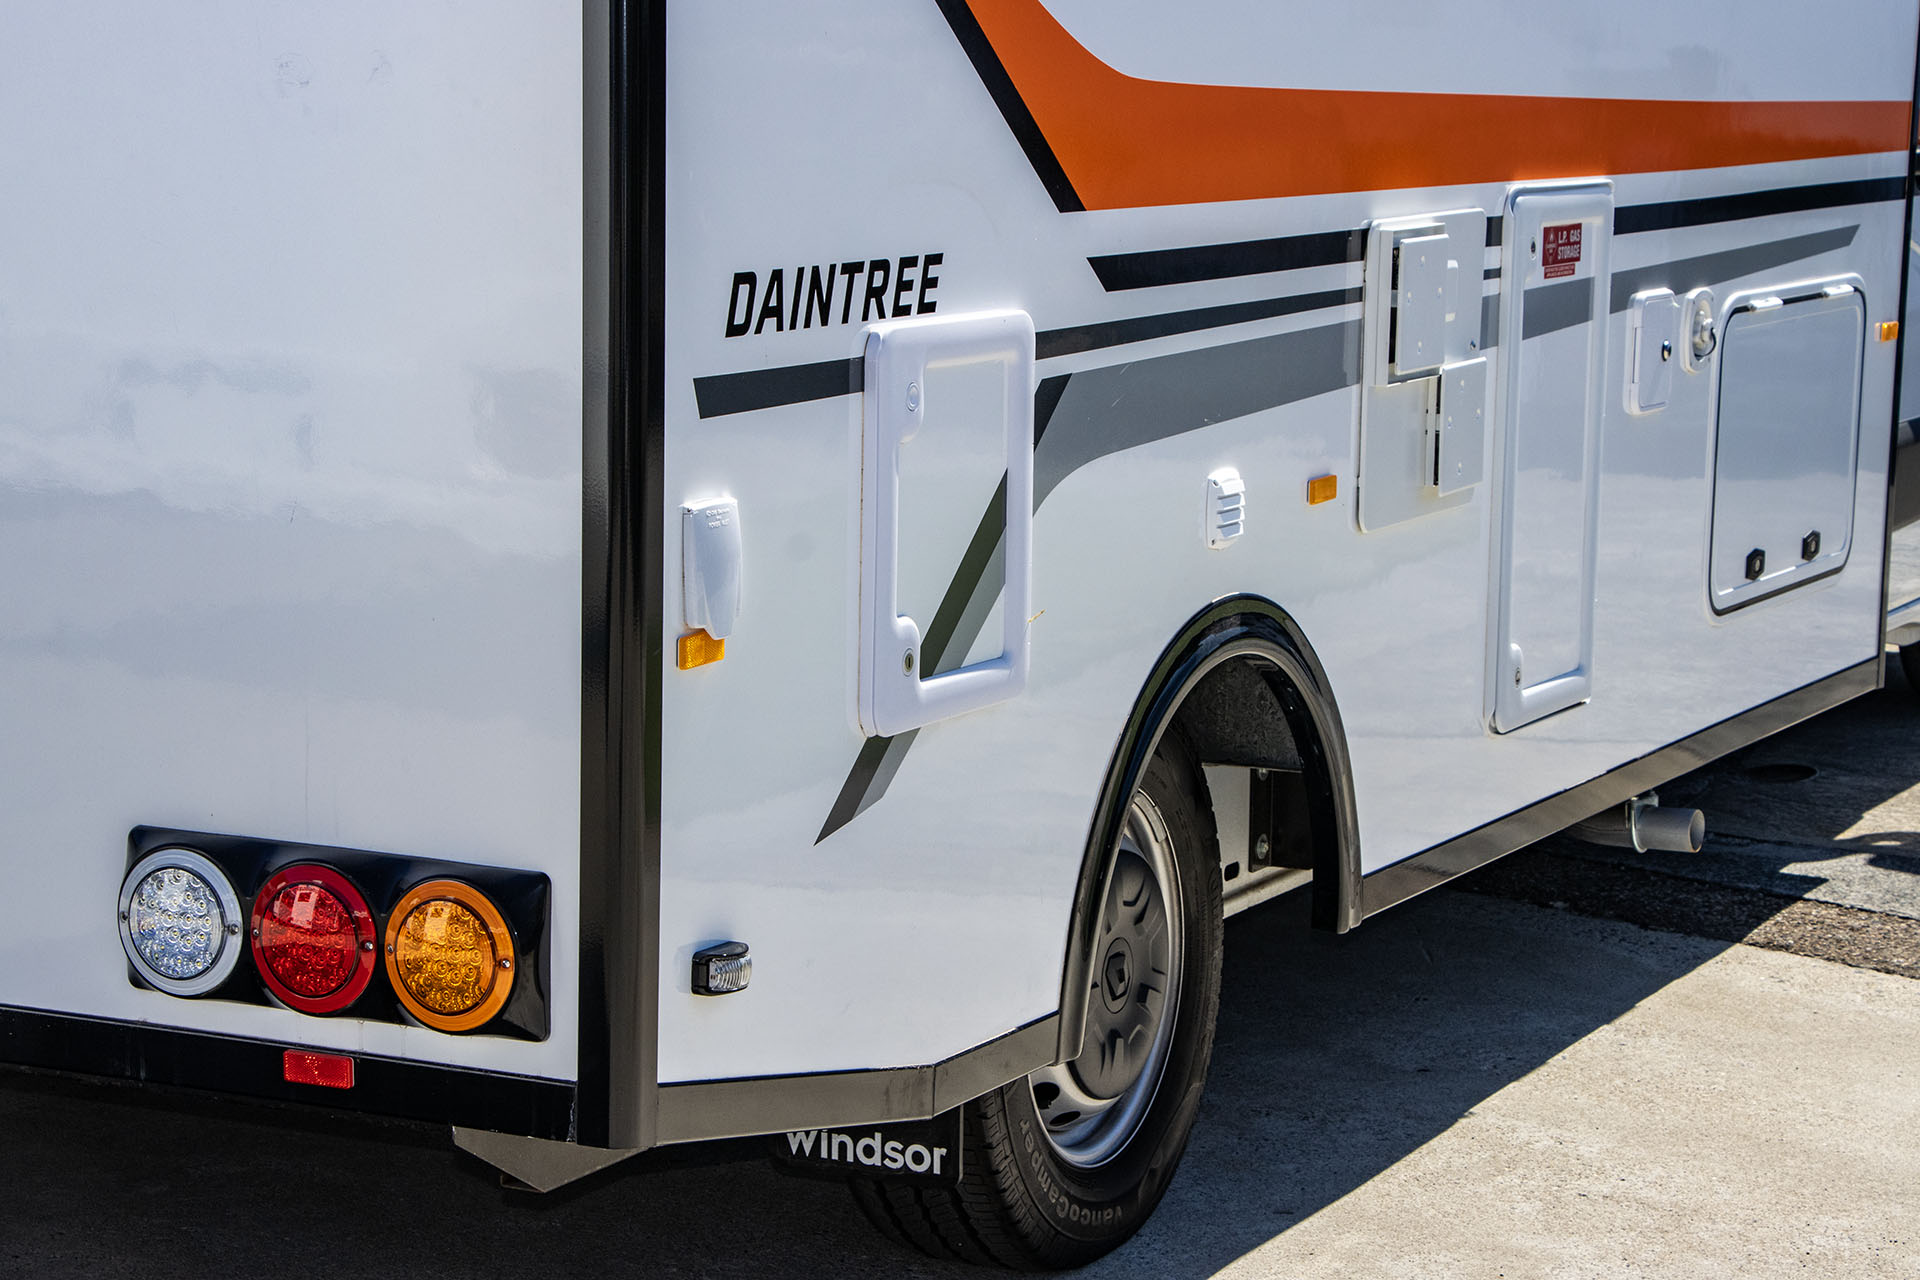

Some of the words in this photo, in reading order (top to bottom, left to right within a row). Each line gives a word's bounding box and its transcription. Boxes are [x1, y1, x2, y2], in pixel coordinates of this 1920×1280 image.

[1570, 229, 1580, 242] GAS
[1558, 244, 1580, 260] STORAGE
[725, 252, 944, 338] DAINTREE
[786, 1129, 947, 1175] windsor
